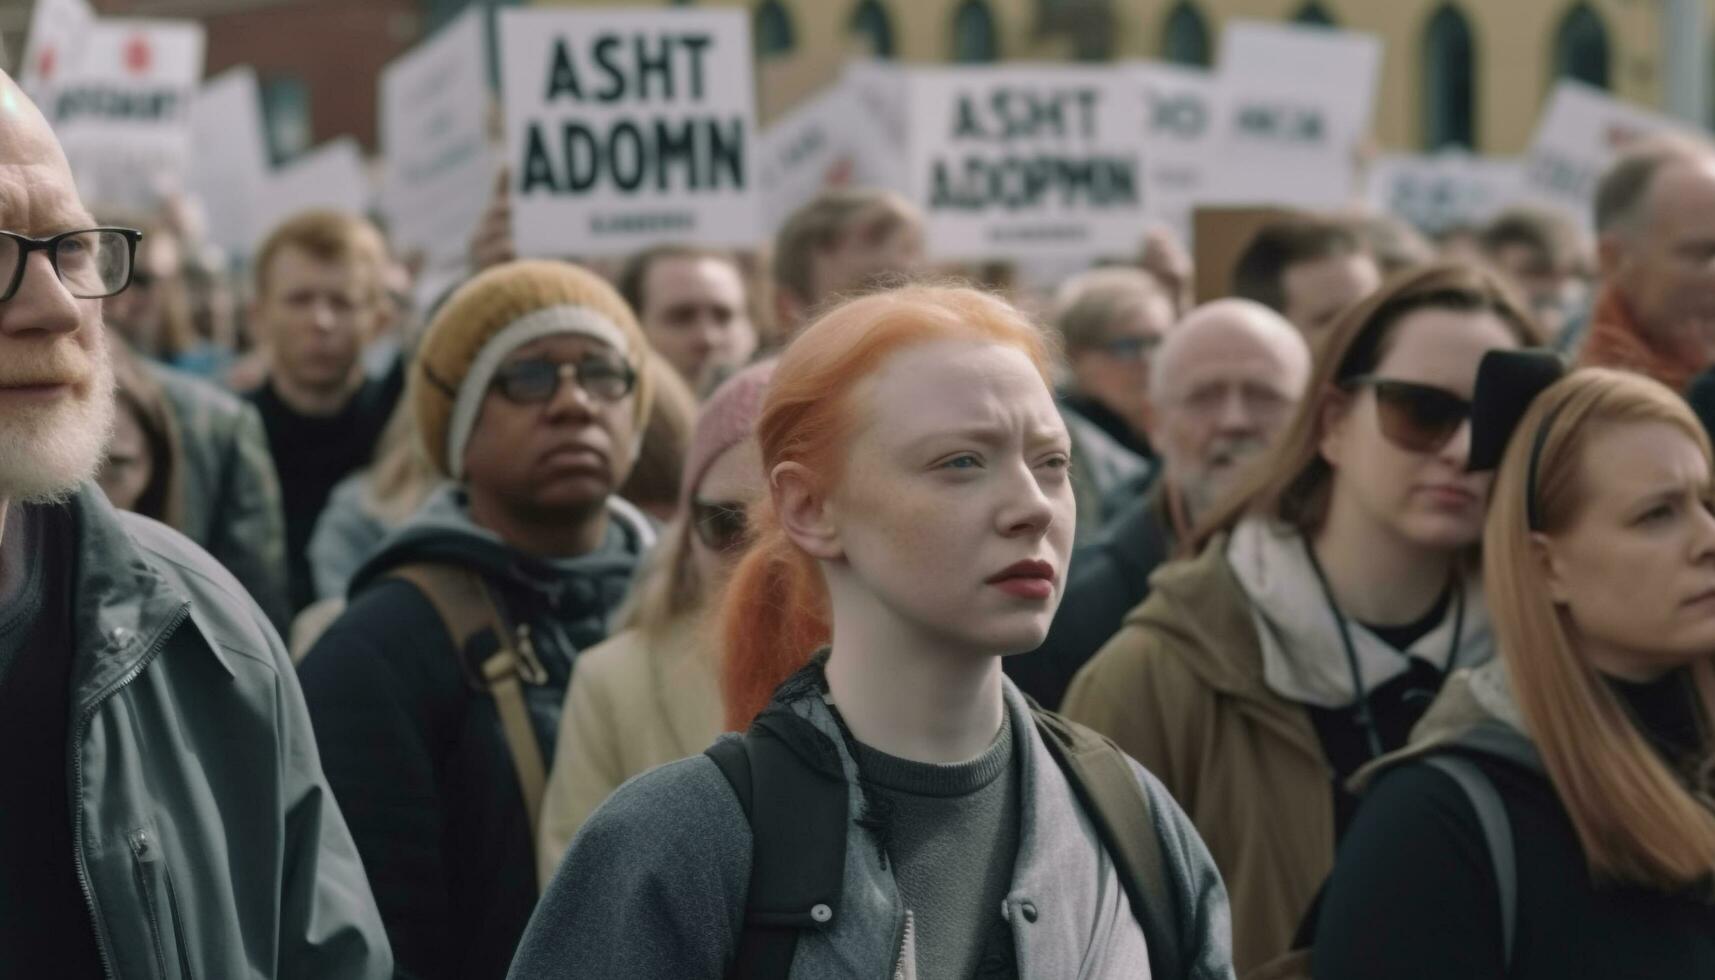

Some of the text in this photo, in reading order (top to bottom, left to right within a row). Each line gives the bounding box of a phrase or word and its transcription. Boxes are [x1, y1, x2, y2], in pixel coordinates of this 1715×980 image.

[545, 34, 711, 102] ASHT
[953, 88, 1098, 140] ASHT
[521, 117, 744, 194] ADOMN
